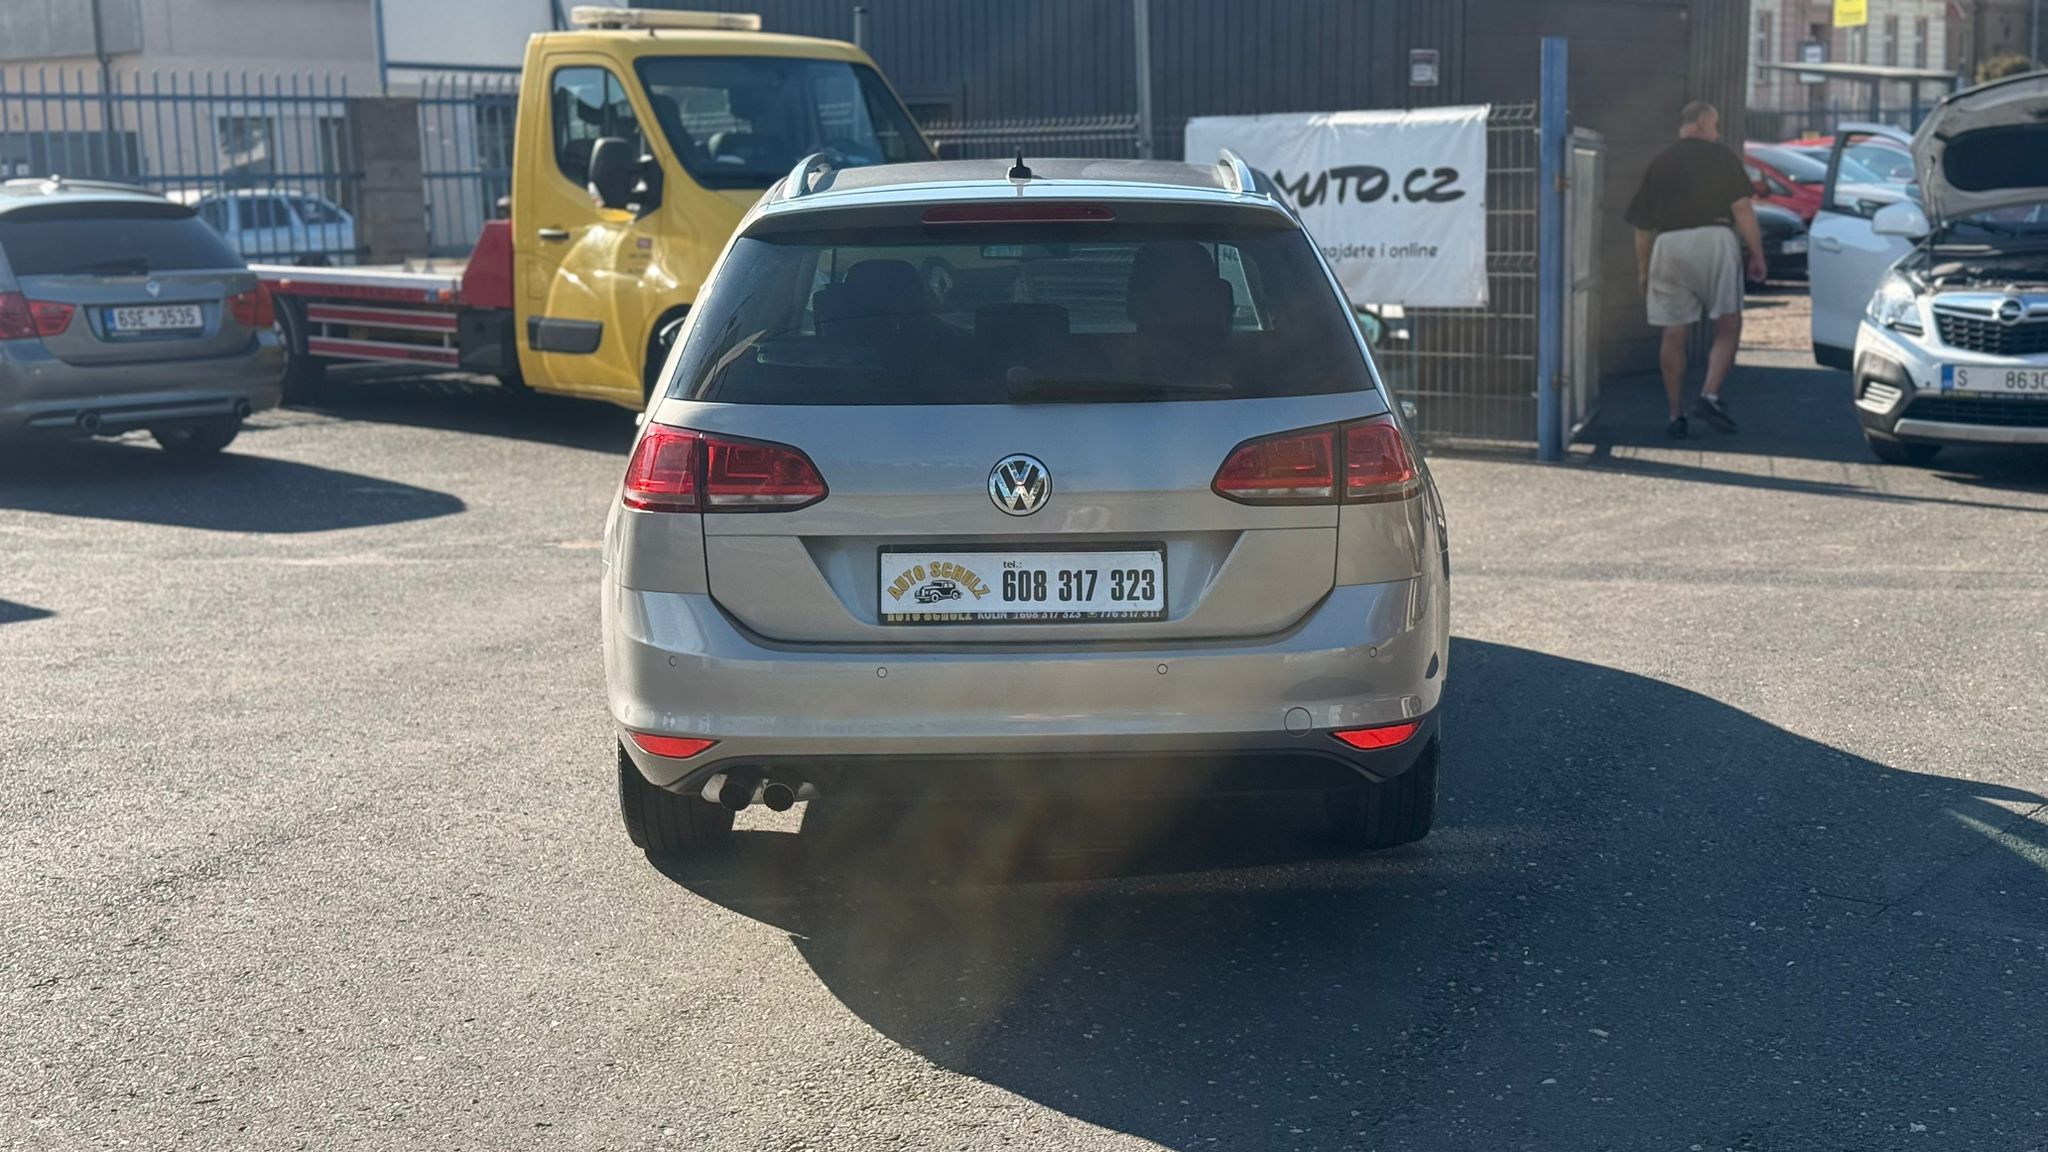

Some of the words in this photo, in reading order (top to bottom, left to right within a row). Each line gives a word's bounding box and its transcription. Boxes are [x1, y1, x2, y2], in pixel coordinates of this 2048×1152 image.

[1389, 243, 1439, 258] online
[118, 309, 147, 328] 6SE
[158, 306, 195, 326] 3535
[1957, 369, 1968, 387] S
[887, 565, 926, 602] AUTO
[929, 561, 991, 601] SCHULZ
[1003, 570, 1047, 602] 608
[1058, 569, 1098, 602] 317
[1111, 568, 1155, 601] 323
